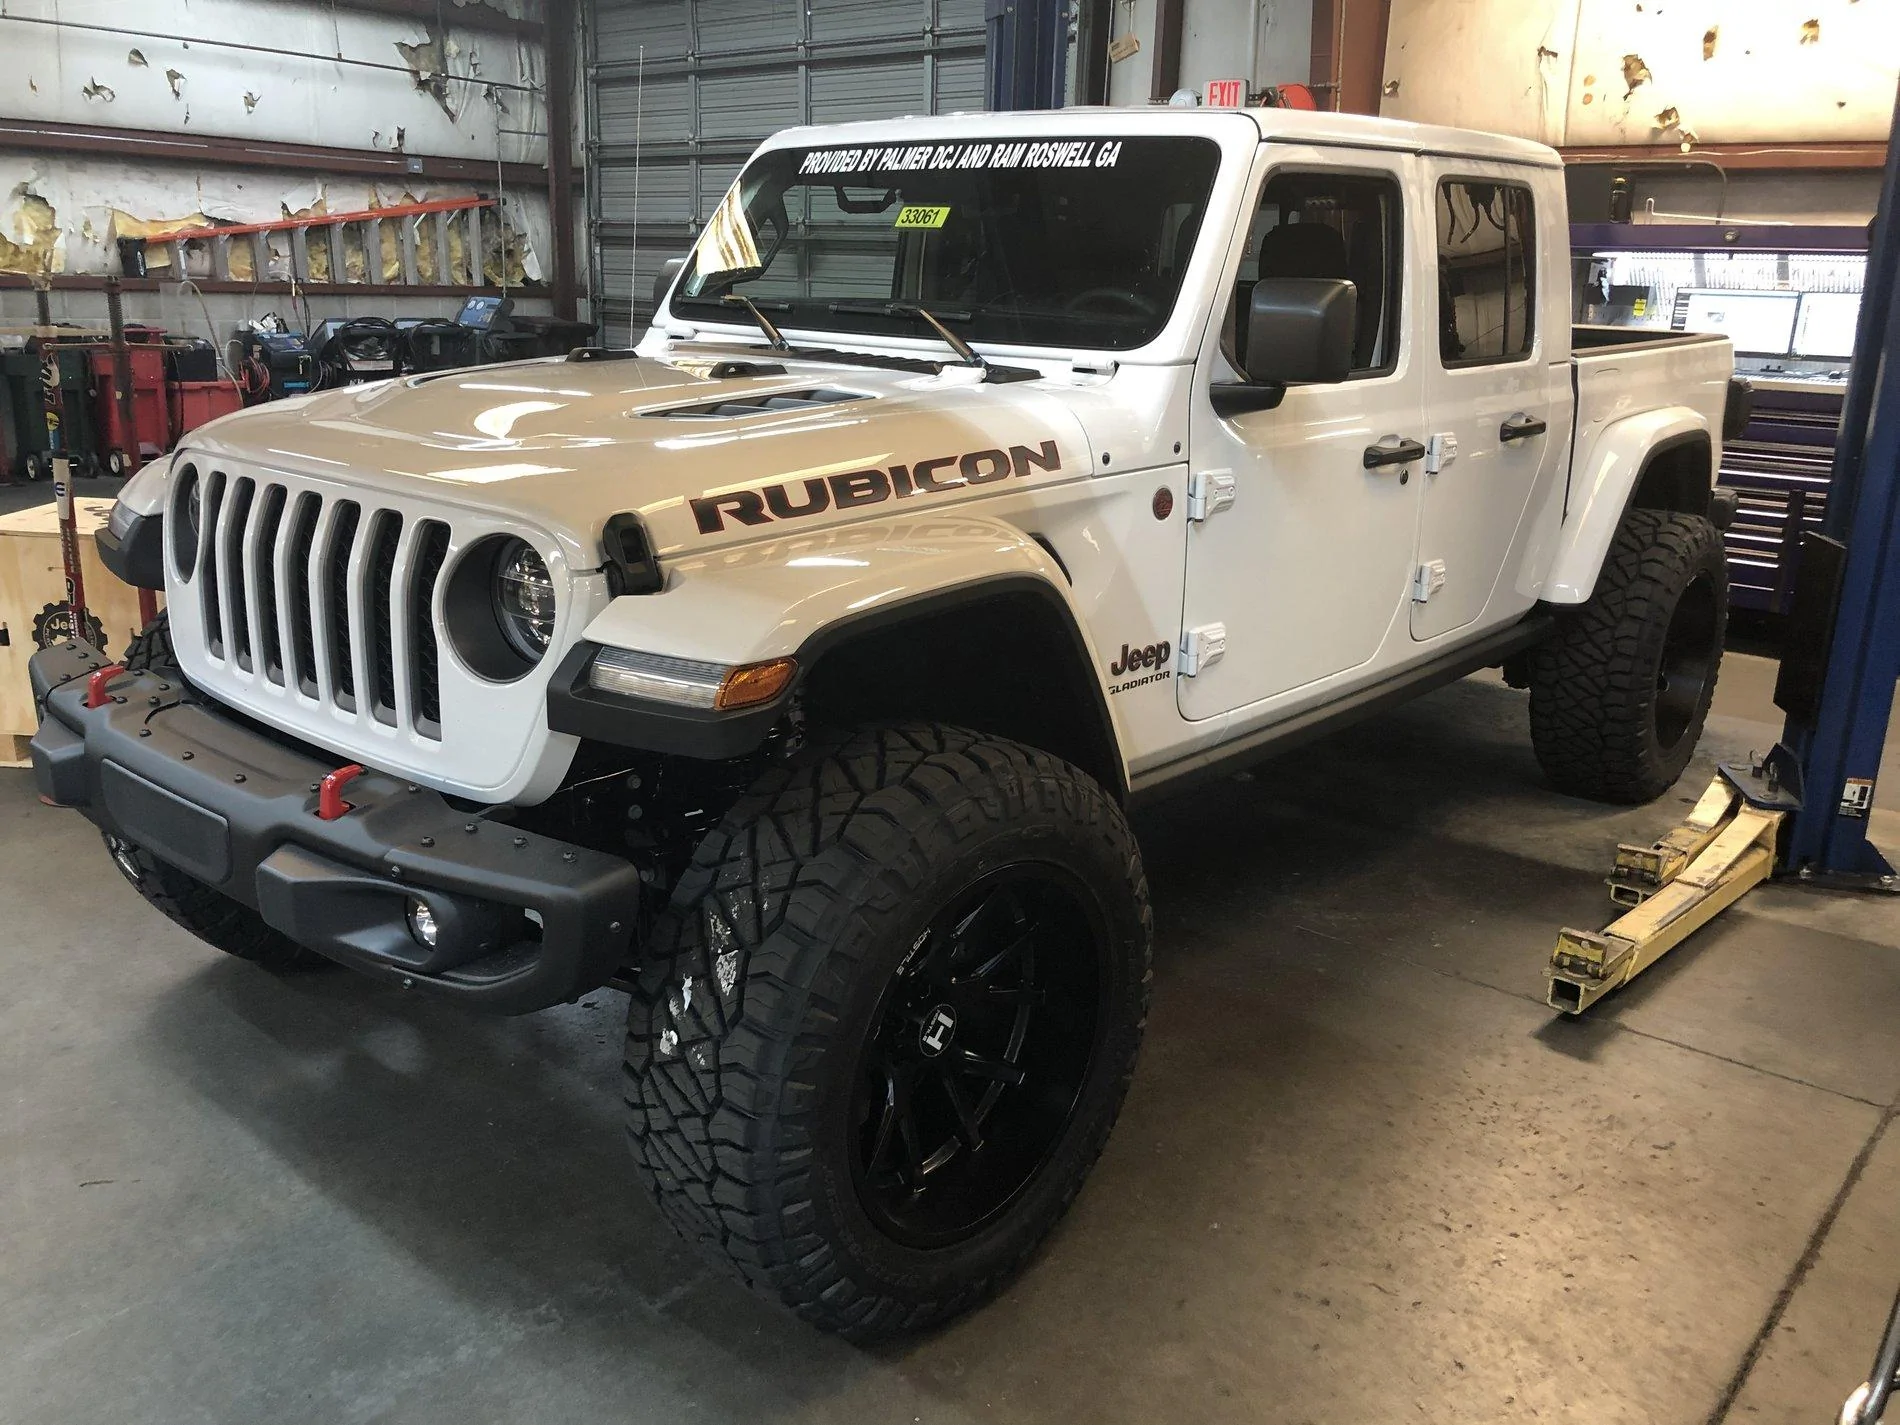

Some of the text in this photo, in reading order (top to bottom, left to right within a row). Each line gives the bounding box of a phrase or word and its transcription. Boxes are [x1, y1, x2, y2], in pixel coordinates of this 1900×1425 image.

[1208, 81, 1241, 107] EXIT
[798, 140, 1123, 175] PROVIDED BY PALMER DCJ AND RAM ROSWELL GA
[900, 208, 941, 225] 33061
[689, 440, 1062, 535] RUBICON
[1110, 640, 1171, 677] Jeep
[1108, 670, 1171, 695] GLADIATOR
[896, 926, 931, 977] HOSTILE
